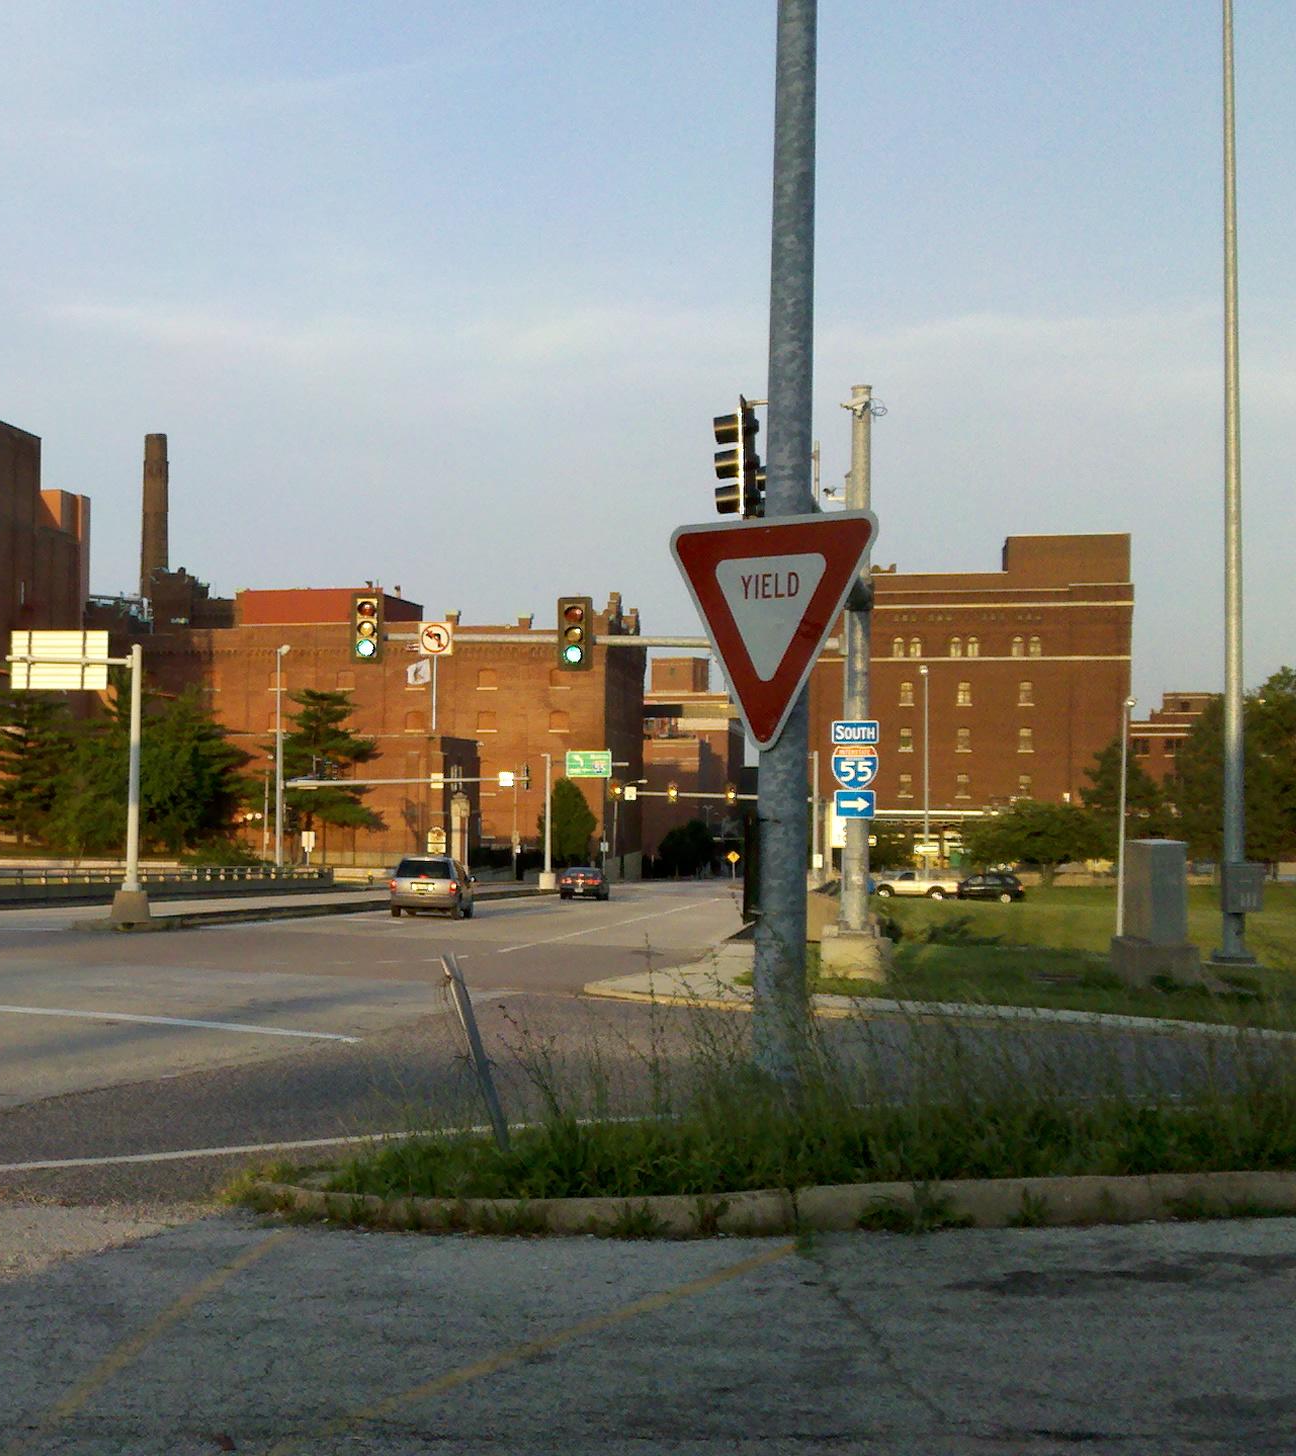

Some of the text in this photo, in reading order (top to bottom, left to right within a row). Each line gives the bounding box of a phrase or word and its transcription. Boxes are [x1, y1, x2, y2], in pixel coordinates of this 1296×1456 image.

[740, 572, 800, 600] YIELD
[835, 725, 876, 740] SOUTH
[840, 761, 873, 782] 55
